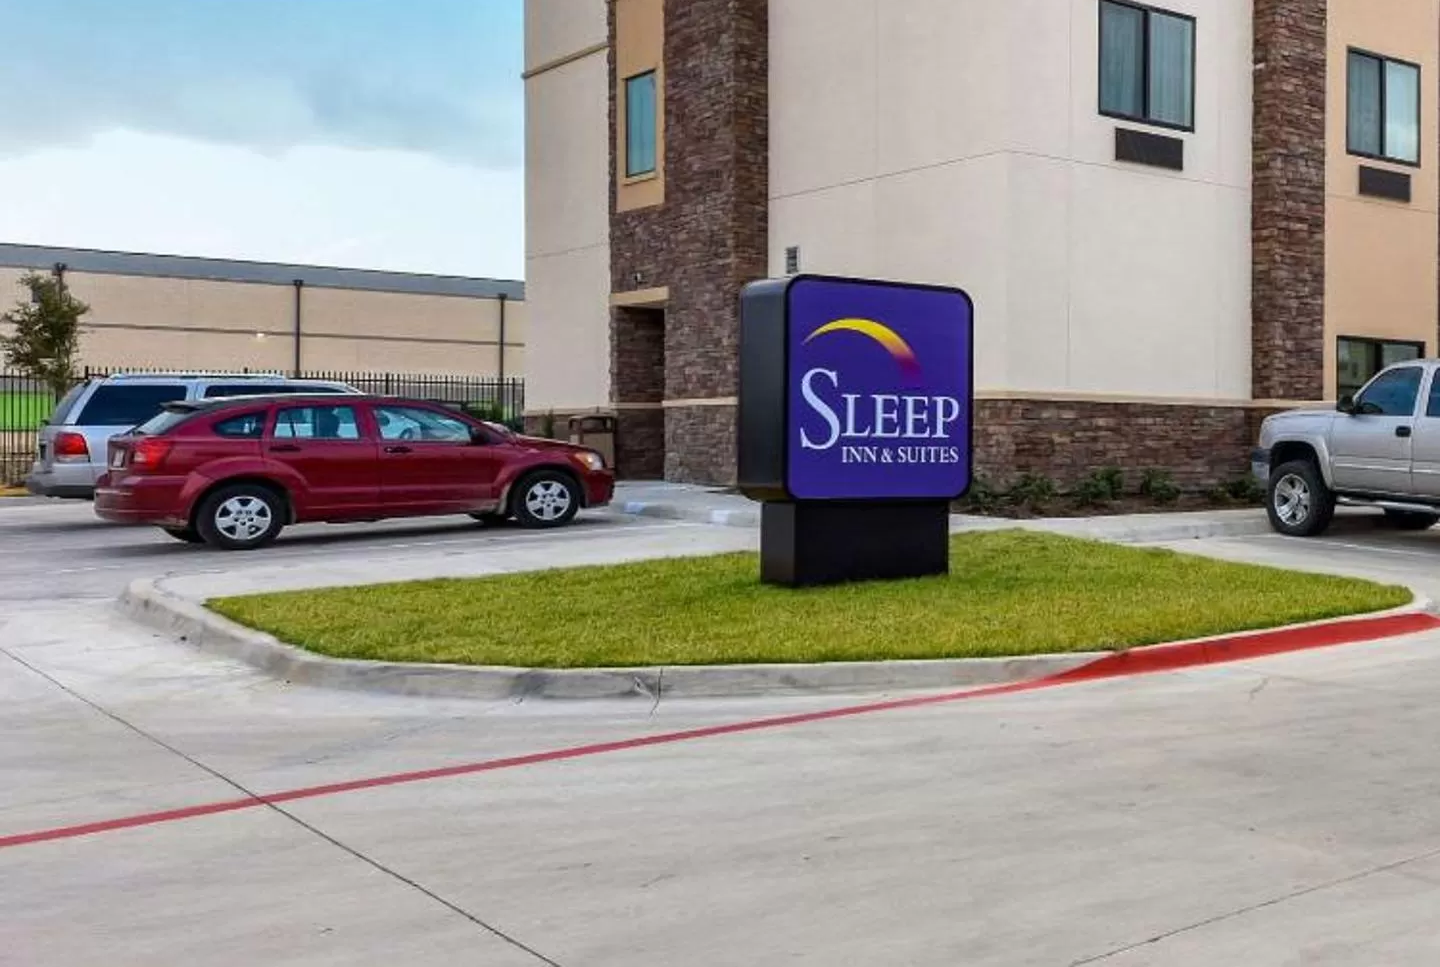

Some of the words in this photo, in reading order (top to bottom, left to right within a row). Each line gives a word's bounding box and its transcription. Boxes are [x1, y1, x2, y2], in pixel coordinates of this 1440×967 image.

[799, 367, 960, 450] SLEEP
[841, 446, 878, 463] INN
[880, 447, 893, 463] &
[897, 446, 959, 463] SUITES
